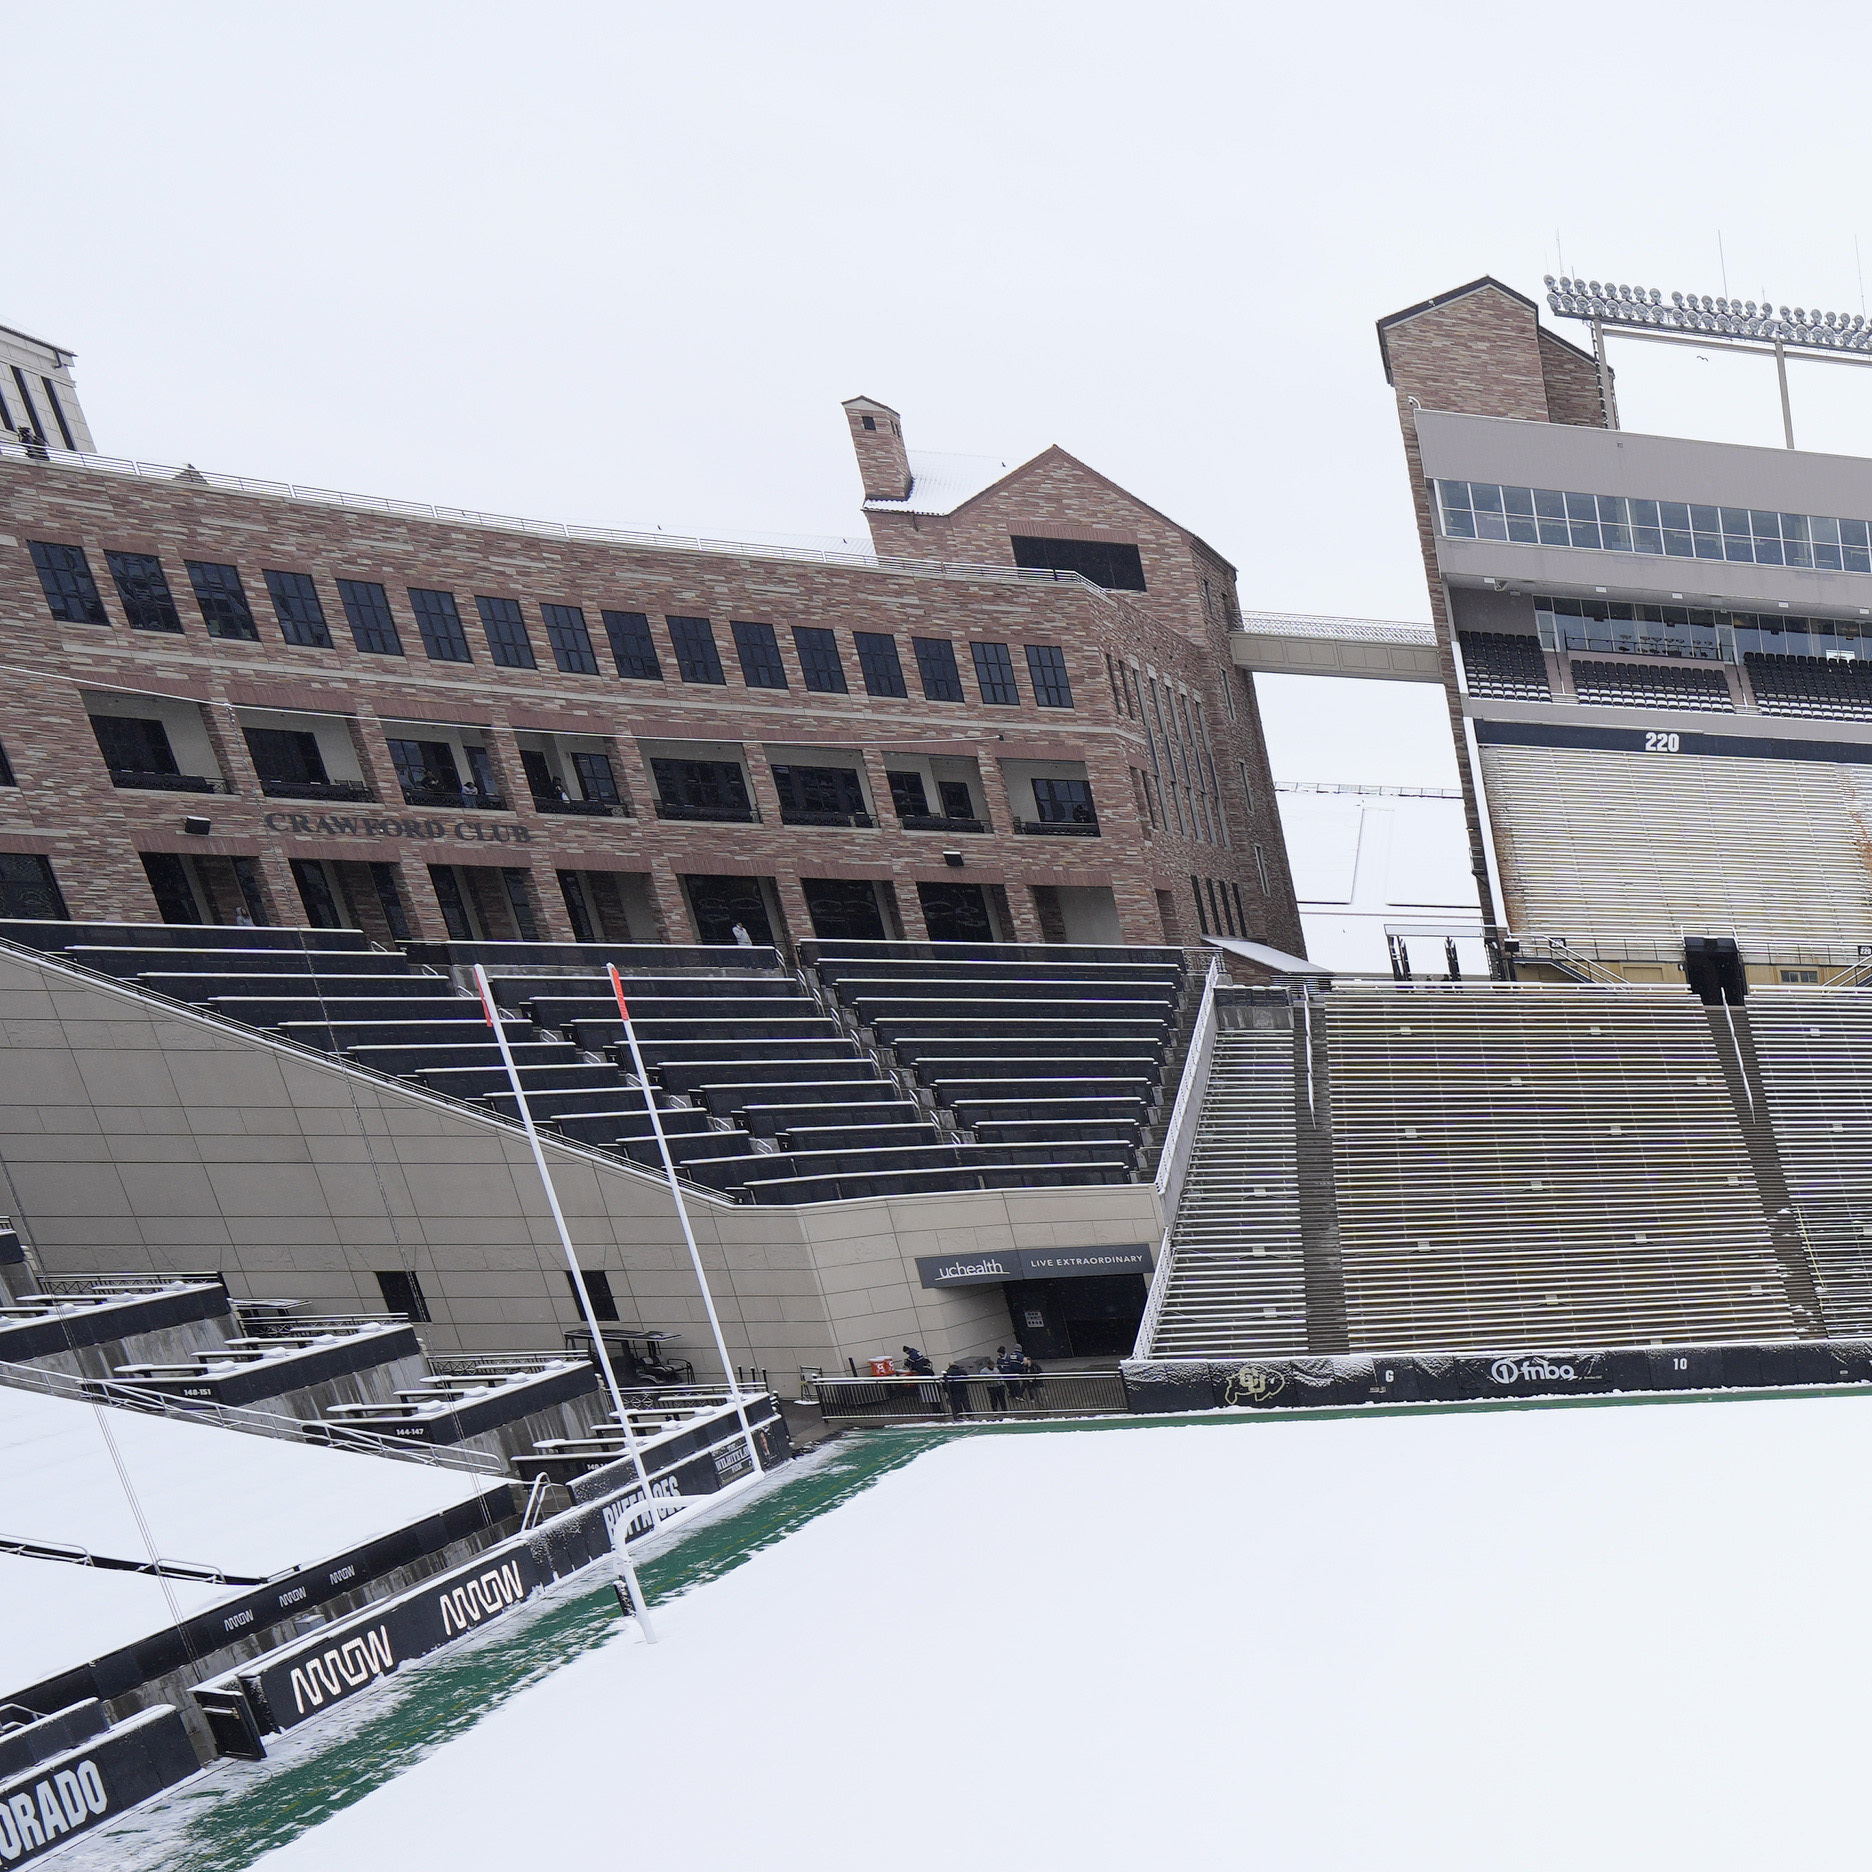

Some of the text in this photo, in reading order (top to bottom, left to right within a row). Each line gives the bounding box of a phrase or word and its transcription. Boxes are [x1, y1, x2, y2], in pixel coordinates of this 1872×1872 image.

[1645, 732, 1680, 753] 220
[264, 812, 532, 843] CRAWFORD CLUB
[939, 1254, 1144, 1279] uchealth LIVE EXTRAORDINARY
[1520, 1361, 1575, 1380] fnbo
[1673, 1358, 1688, 1370] 10
[1385, 1369, 1394, 1382] G
[183, 1388, 212, 1397] 148-151
[395, 1428, 424, 1436] 144-147
[602, 1475, 684, 1547] BUFFAOES
[328, 1564, 356, 1586] ARROW
[278, 1585, 307, 1608] ARROW
[438, 1559, 525, 1636] ARROW
[223, 1608, 255, 1632] ARROW
[289, 1624, 394, 1715] ARROW
